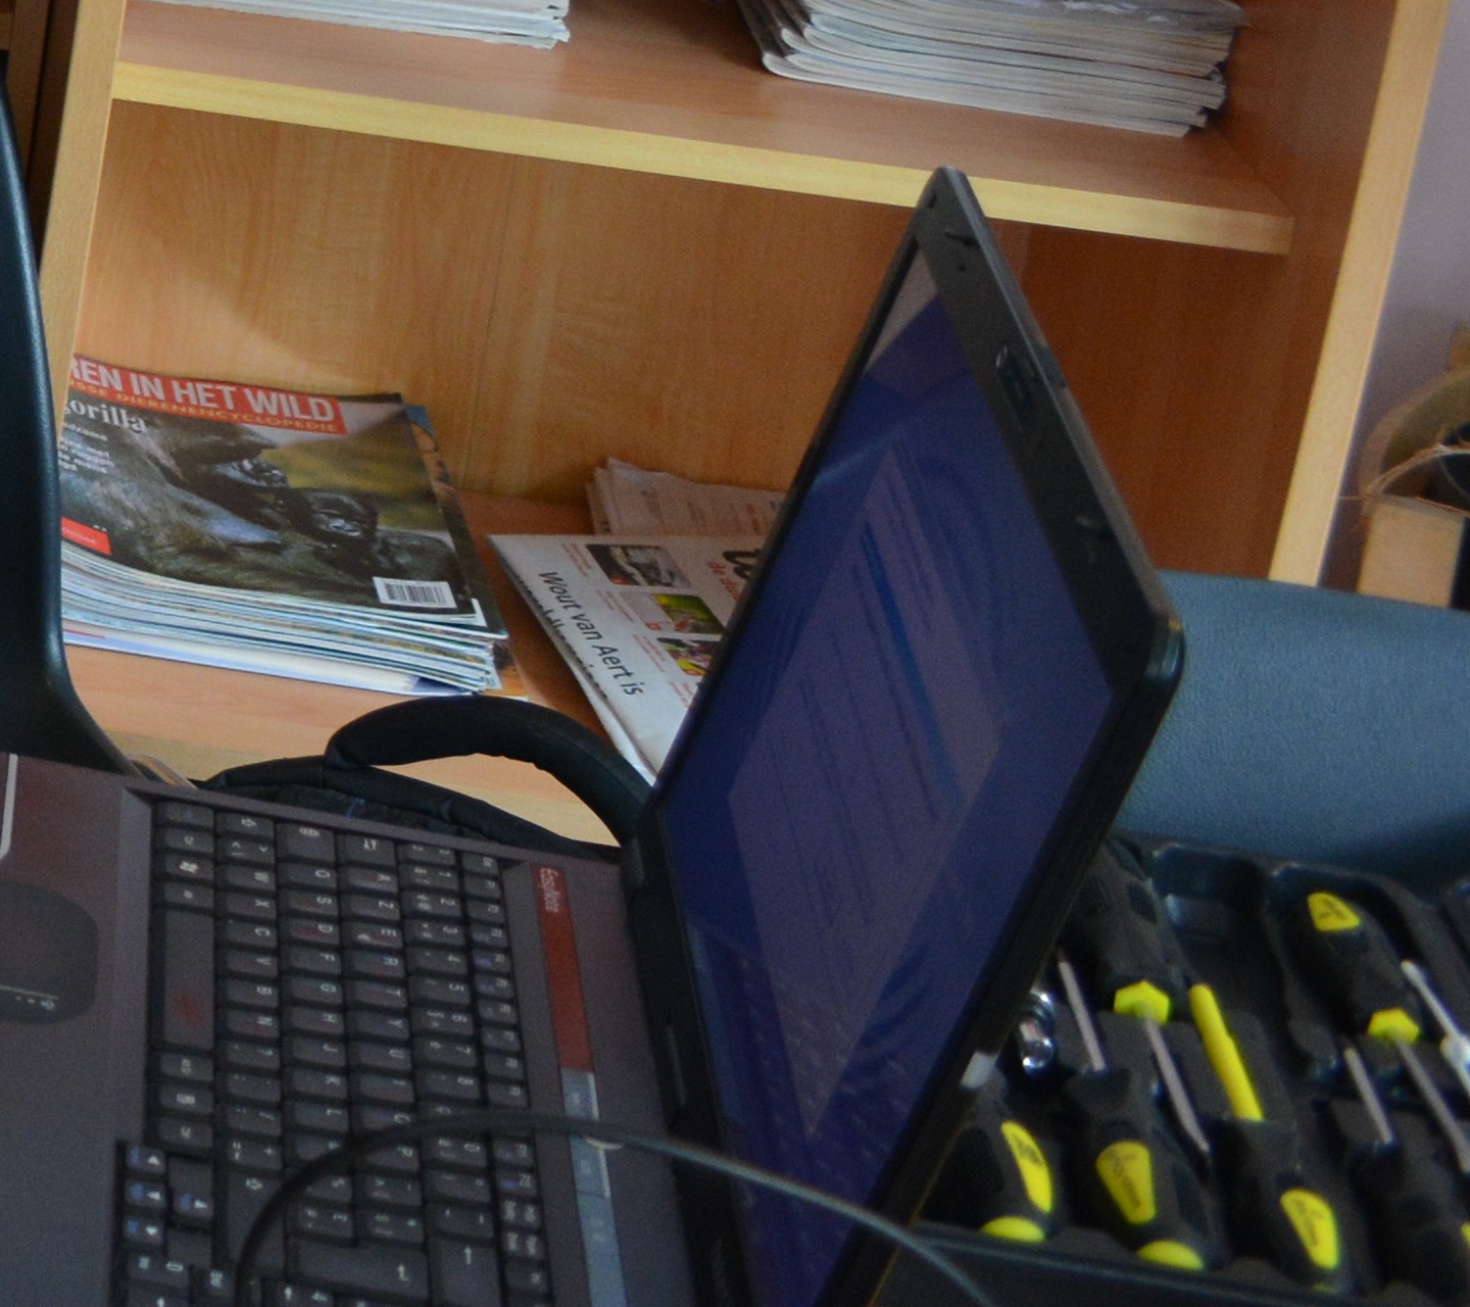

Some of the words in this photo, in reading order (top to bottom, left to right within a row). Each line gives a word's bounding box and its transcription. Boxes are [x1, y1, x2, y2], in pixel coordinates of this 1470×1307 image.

[130, 372, 166, 401] IN
[172, 379, 238, 410] HET
[244, 387, 336, 422] WILD
[539, 570, 582, 612] Wout
[570, 608, 603, 642] van
[592, 645, 634, 680] Aert
[620, 681, 645, 697] is
